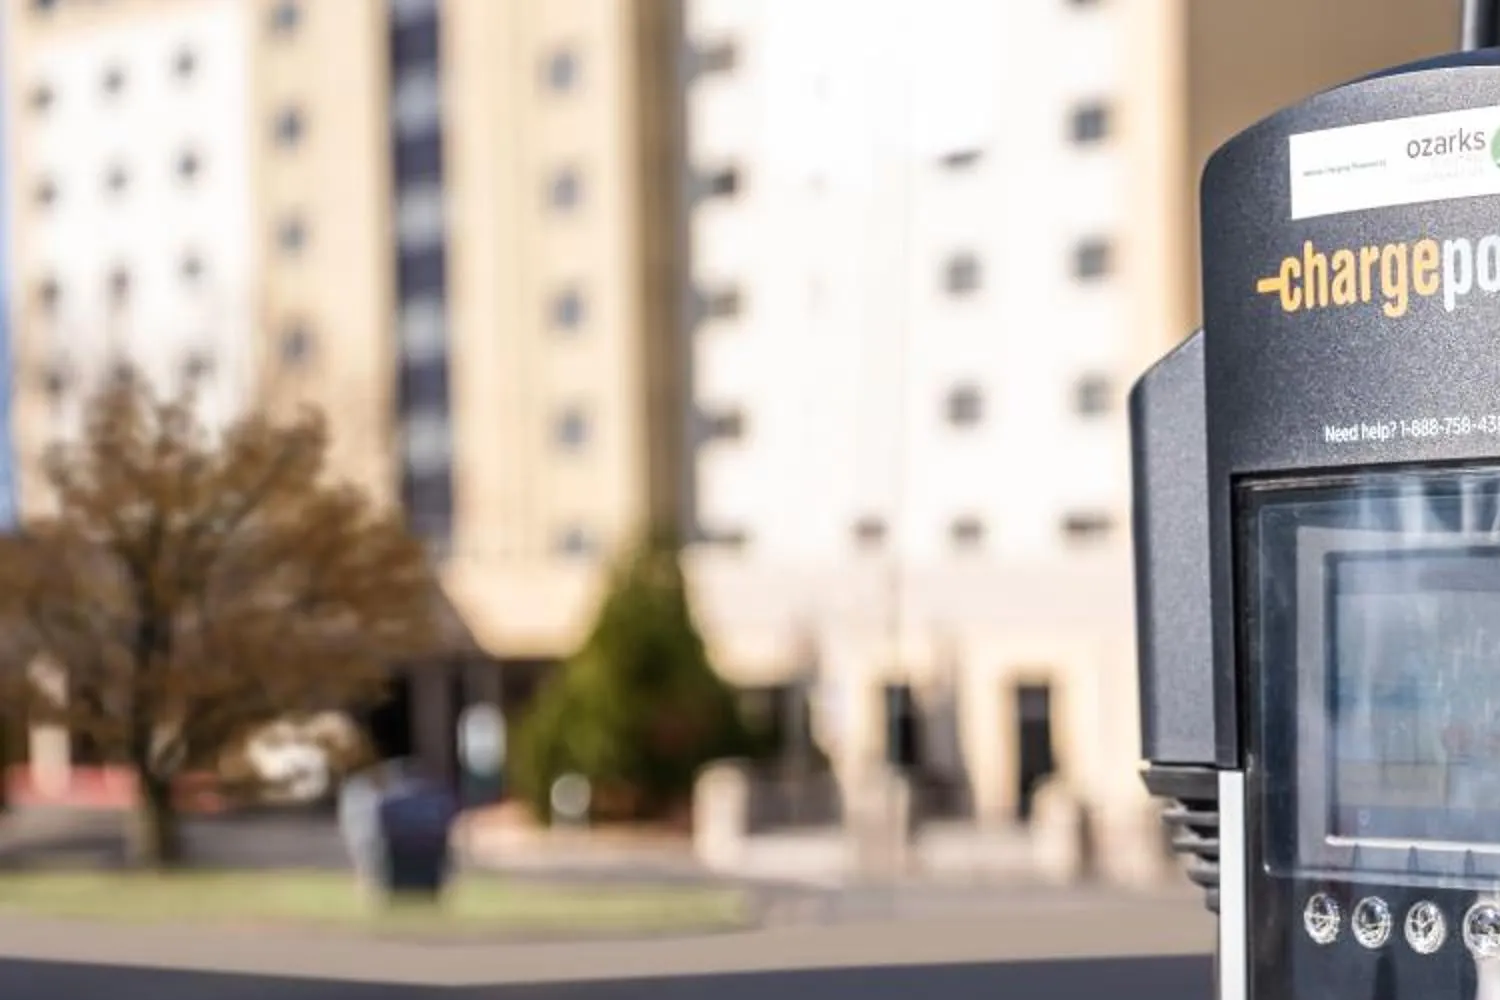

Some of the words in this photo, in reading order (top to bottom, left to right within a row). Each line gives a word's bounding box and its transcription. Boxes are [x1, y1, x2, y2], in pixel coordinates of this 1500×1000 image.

[1406, 127, 1486, 159] ozarks
[1325, 423, 1359, 443] Need
[1361, 420, 1397, 442] help?
